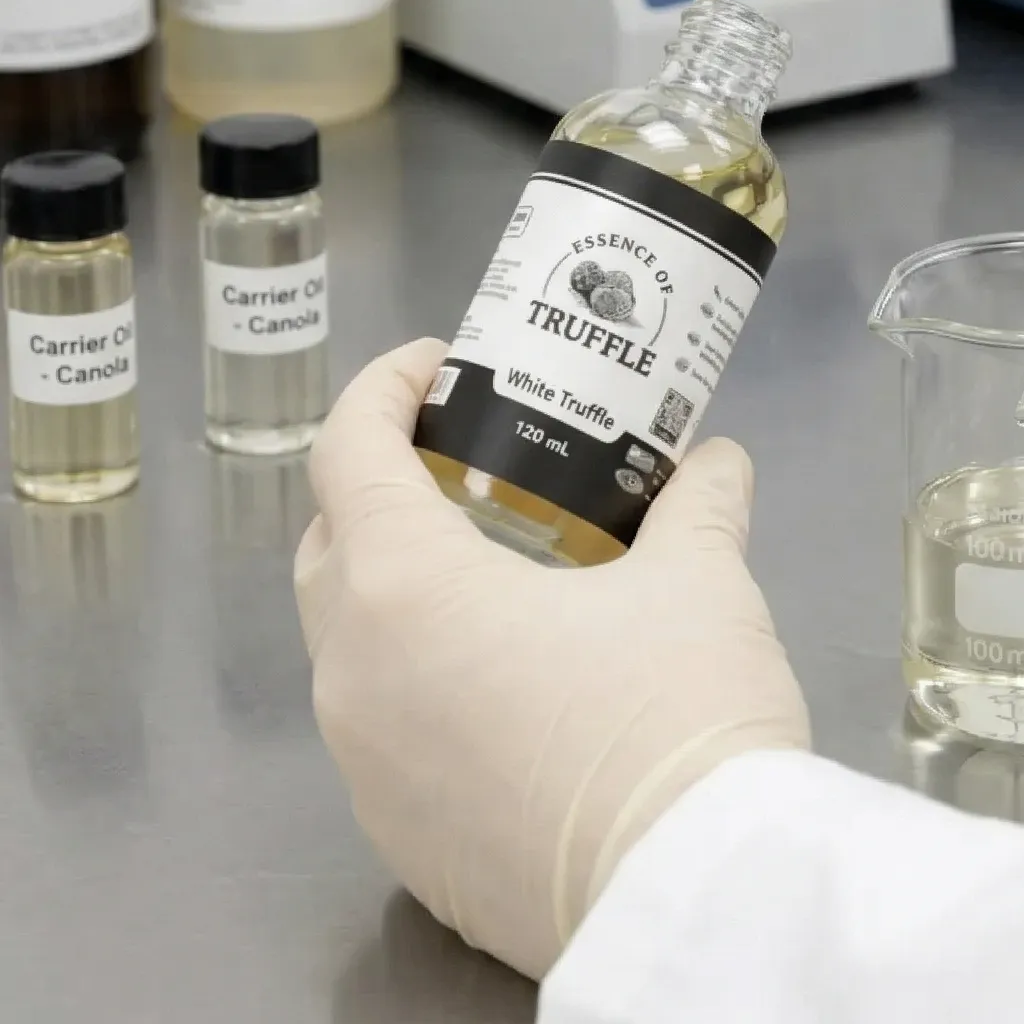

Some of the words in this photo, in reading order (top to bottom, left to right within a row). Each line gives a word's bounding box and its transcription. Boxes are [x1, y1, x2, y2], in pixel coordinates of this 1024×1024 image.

[572, 233, 656, 267] ESSENCE
[654, 269, 674, 295] OF
[222, 284, 298, 306] Carrier
[29, 334, 108, 356] Carrier
[525, 299, 657, 378] TRUFFLE
[507, 367, 556, 402] White
[559, 390, 616, 430] Truffle
[515, 420, 544, 445] 120
[545, 438, 570, 457] mL
[966, 534, 1005, 562] 100
[965, 636, 1003, 664] 100
